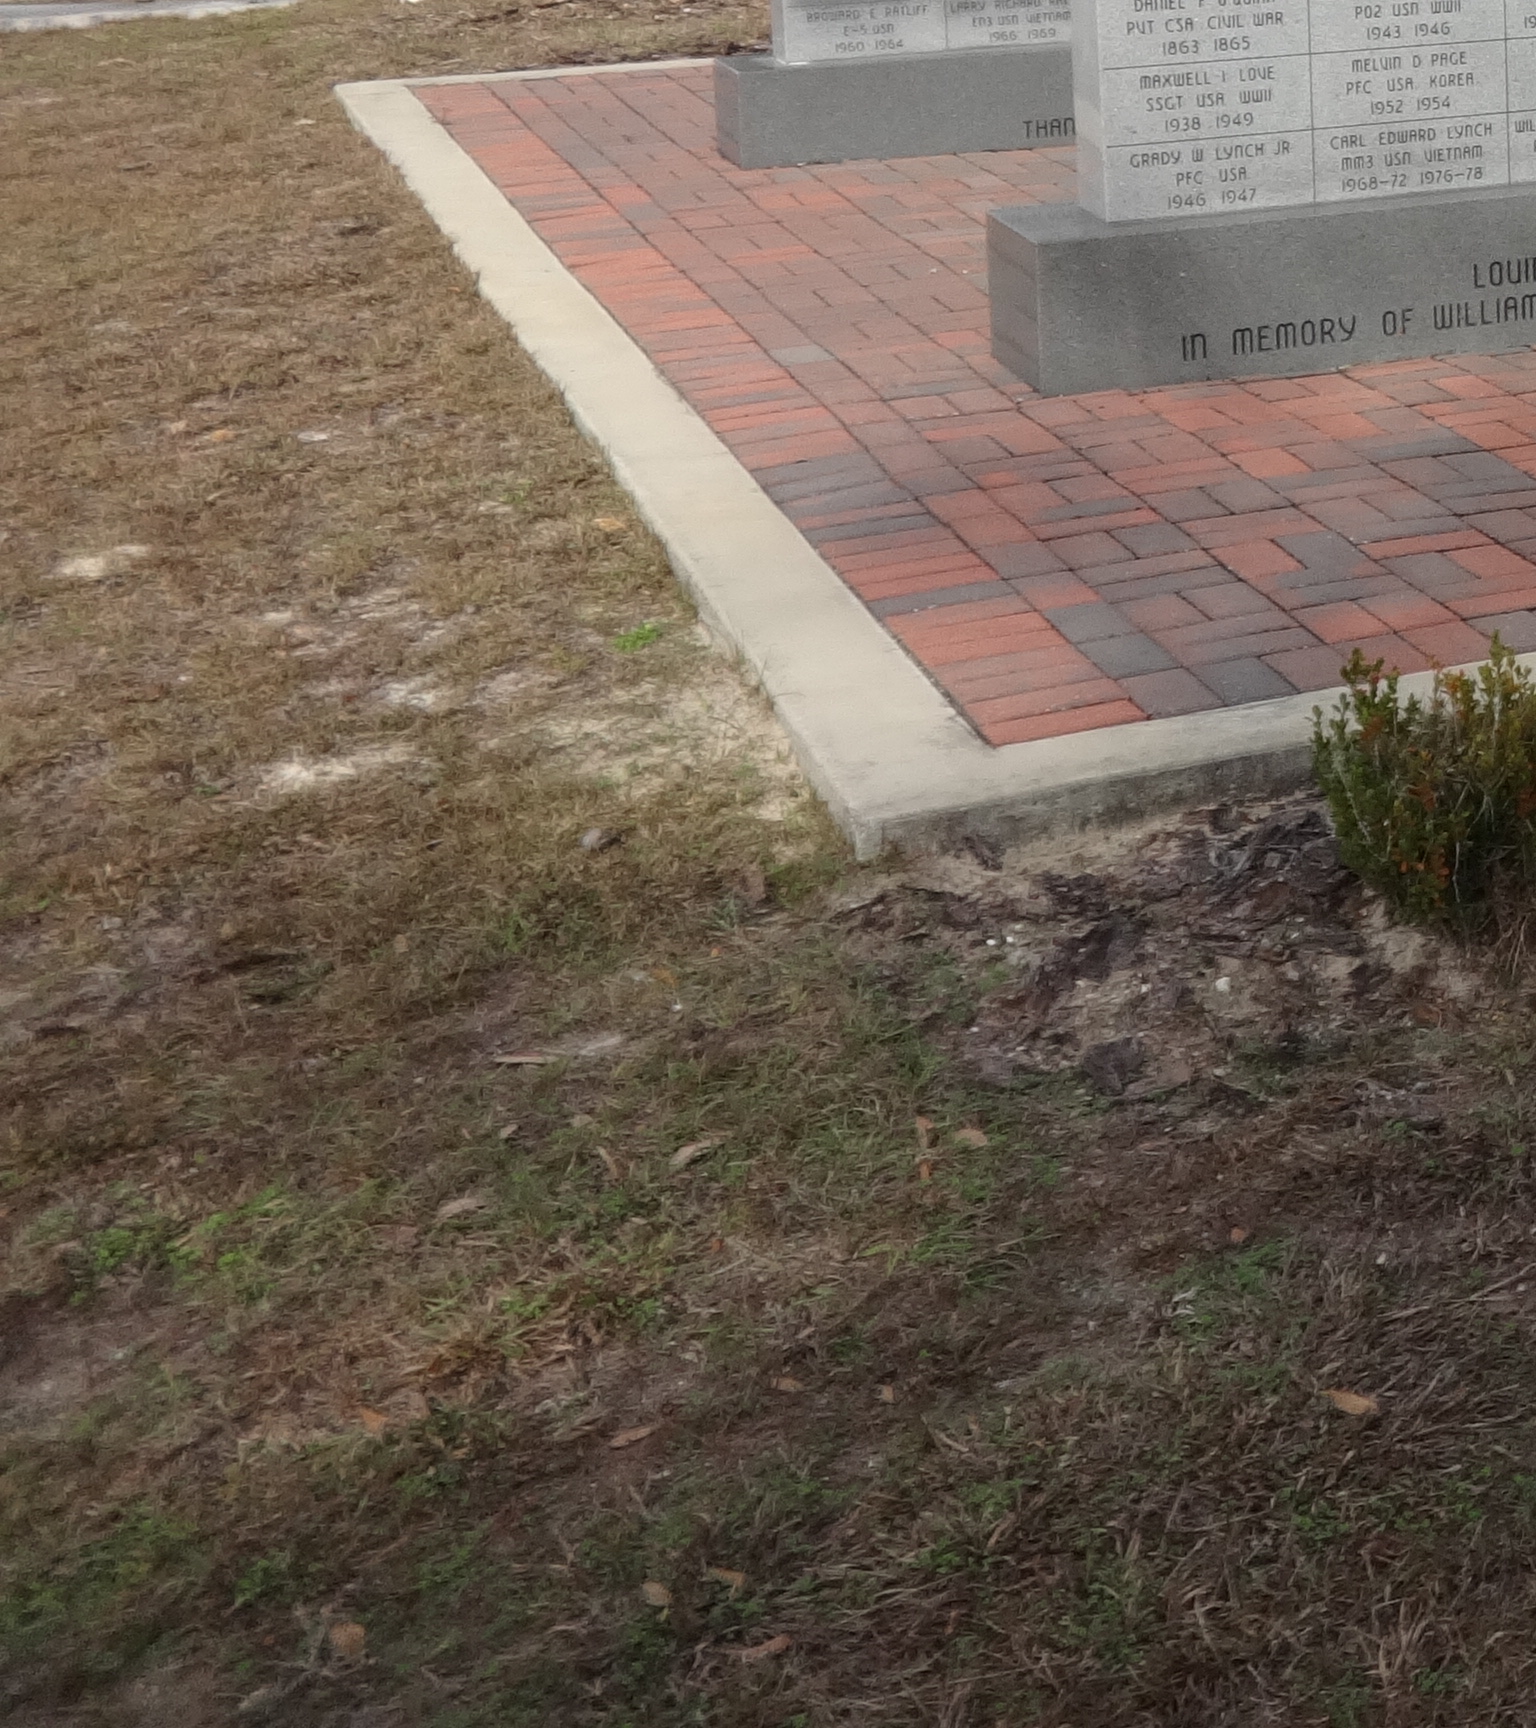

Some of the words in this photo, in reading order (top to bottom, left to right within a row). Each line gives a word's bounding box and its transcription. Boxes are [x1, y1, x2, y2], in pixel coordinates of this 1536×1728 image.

[1022, 118, 1076, 139] THAN
[1180, 332, 1208, 363] IN
[1232, 314, 1357, 357] MEMORY
[1381, 308, 1415, 338] OF
